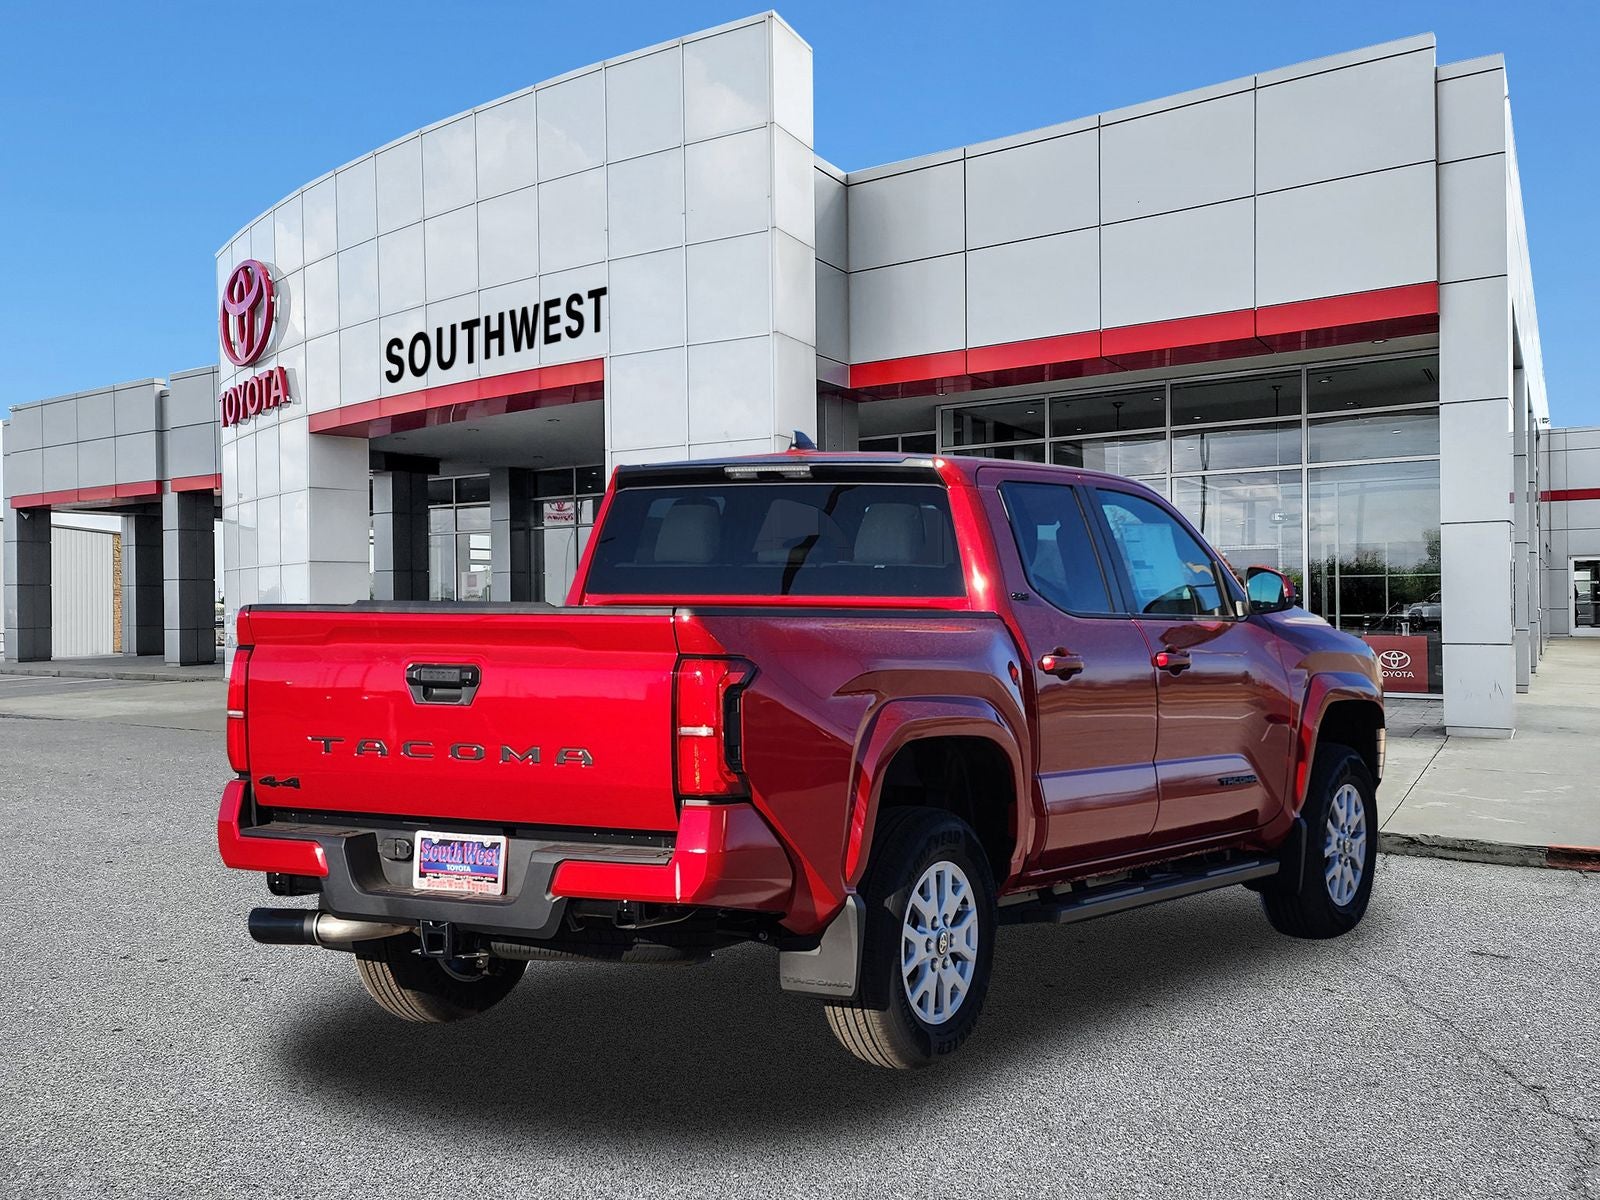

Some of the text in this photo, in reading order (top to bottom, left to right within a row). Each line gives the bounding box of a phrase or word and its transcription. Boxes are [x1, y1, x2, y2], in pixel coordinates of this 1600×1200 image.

[385, 286, 608, 384] SOUTHWEST
[219, 366, 291, 428] TOYOTA
[1382, 670, 1415, 678] OYOTA
[307, 735, 594, 767] TACOMA
[446, 864, 471, 872] TOYOTA
